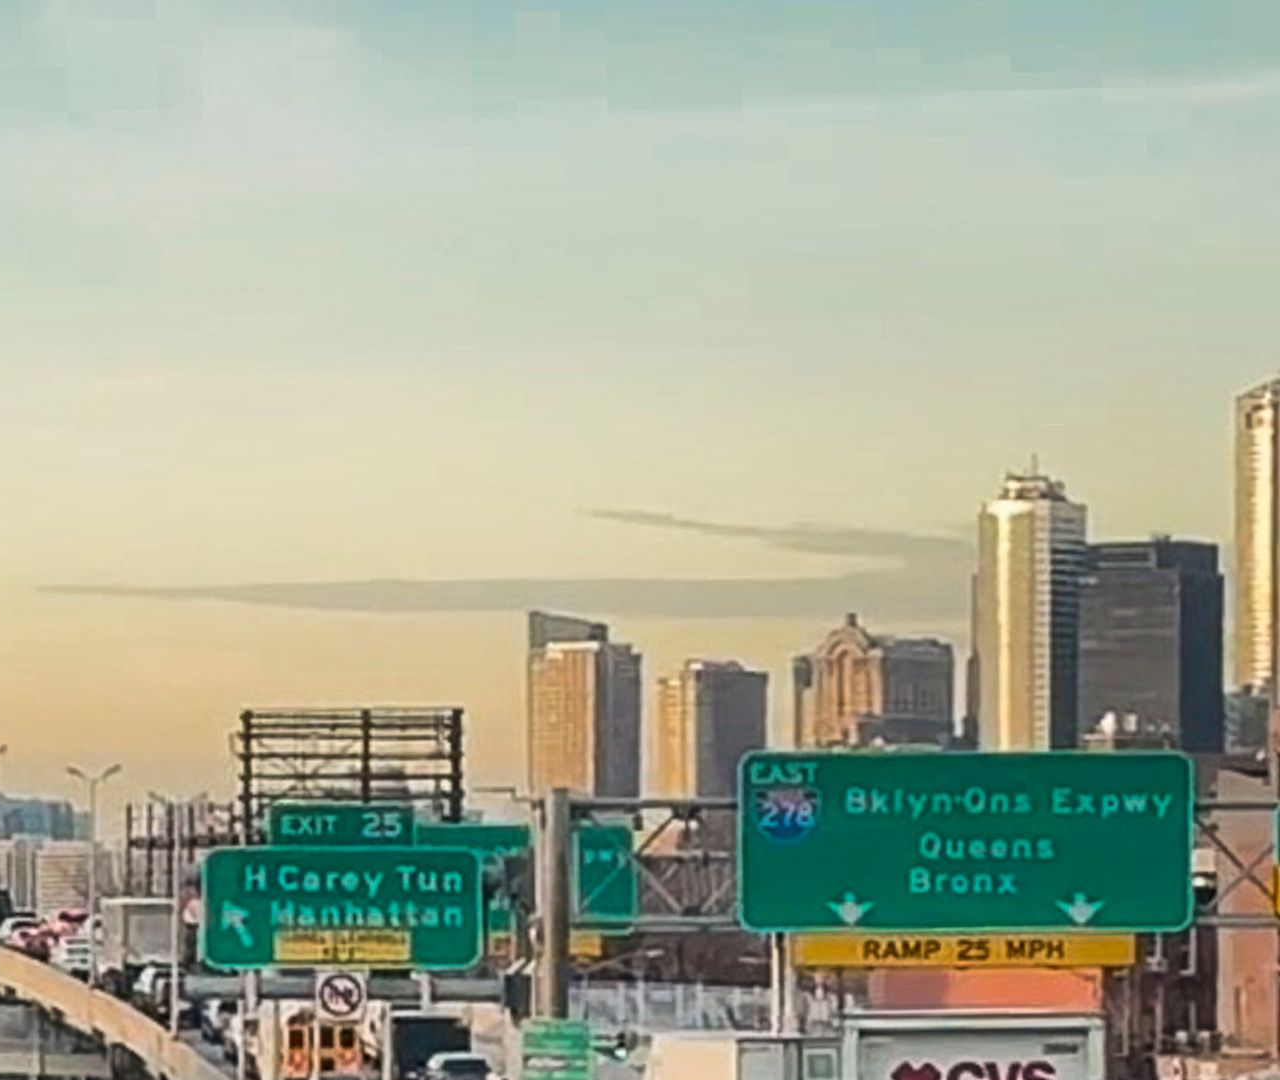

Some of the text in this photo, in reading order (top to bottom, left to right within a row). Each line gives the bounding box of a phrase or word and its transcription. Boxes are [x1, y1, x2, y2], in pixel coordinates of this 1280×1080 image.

[749, 762, 819, 784] EAST
[759, 802, 815, 828] 278
[1051, 787, 1173, 818] Expwy
[280, 812, 402, 838] EXIT 25
[919, 831, 1055, 860] Queens
[244, 864, 463, 897] H Carey Tun
[909, 866, 1018, 894] Bronx
[270, 900, 464, 927] Manhattan
[862, 940, 1066, 960] RAMP 25 MPH
